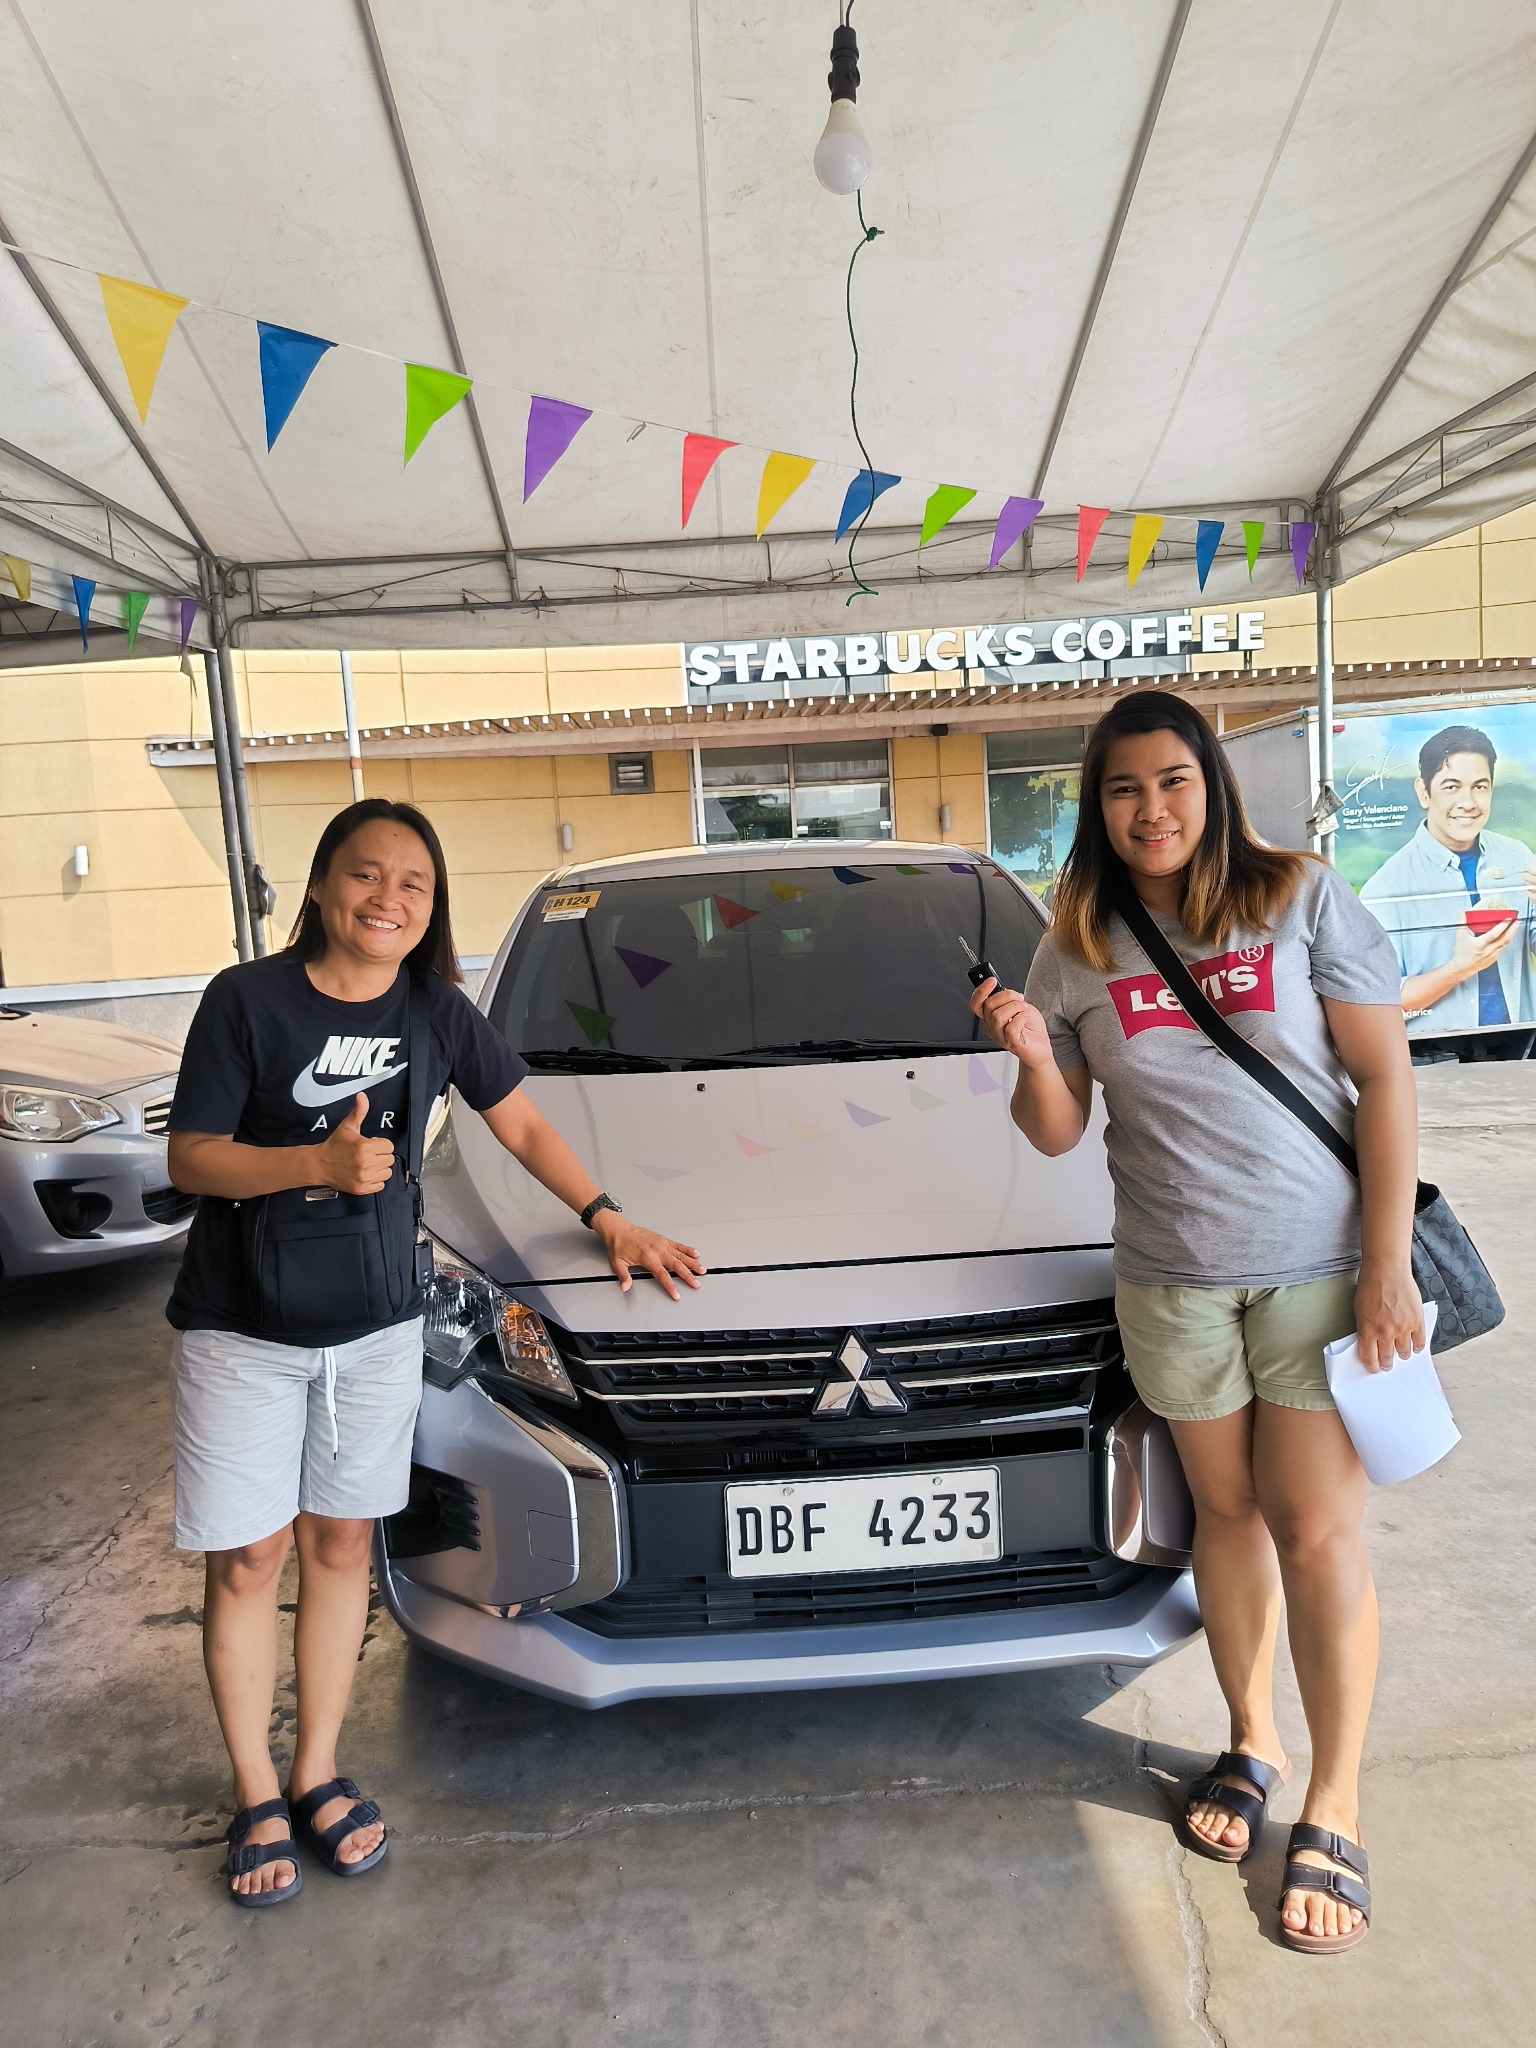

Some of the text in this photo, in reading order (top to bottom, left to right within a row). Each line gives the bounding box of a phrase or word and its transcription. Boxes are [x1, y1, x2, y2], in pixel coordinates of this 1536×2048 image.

[689, 611, 1265, 687] STARBUCKS COFFEE
[1342, 808, 1363, 817] Gary
[315, 1035, 401, 1075] NIKE
[310, 1111, 395, 1131] AR
[737, 1491, 990, 1556] DBF 4233
